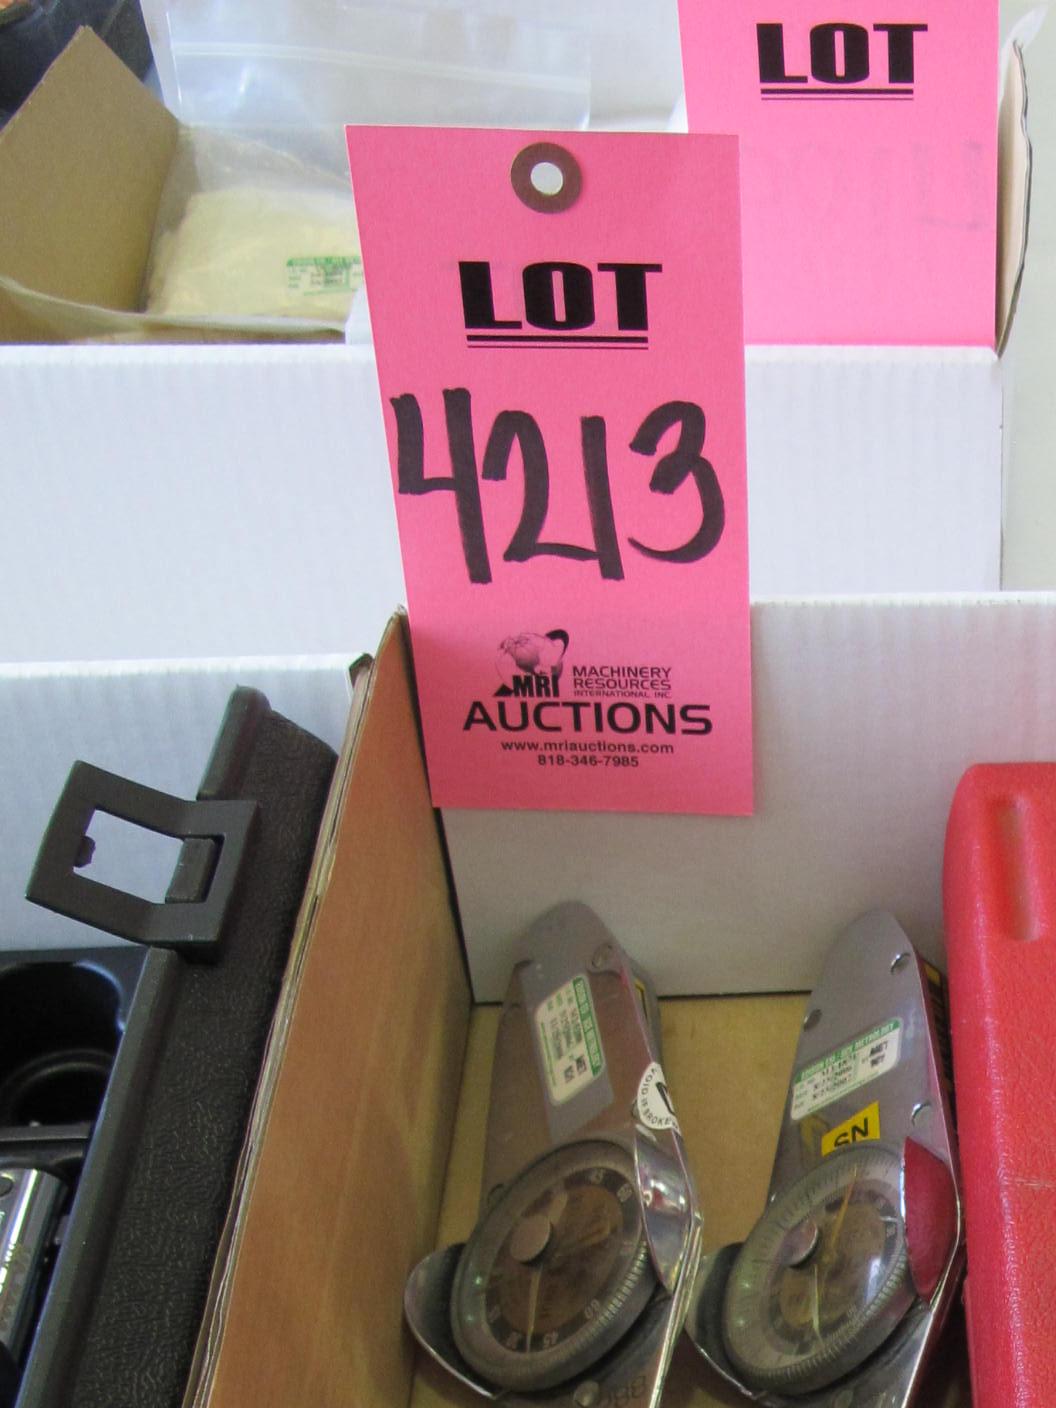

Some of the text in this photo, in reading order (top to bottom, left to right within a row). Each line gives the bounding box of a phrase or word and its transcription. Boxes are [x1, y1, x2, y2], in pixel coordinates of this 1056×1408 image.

[756, 22, 928, 84] LOT
[458, 261, 663, 331] LOT
[389, 386, 726, 584] 4213
[572, 665, 673, 680] MACHINERY
[512, 671, 560, 698] MRI
[573, 679, 672, 691] RESOURCES
[573, 690, 650, 698] INTERNATIONAL
[462, 700, 713, 735] AUCTIONS
[500, 740, 675, 754] www.mriauctions.com
[537, 754, 639, 767] 818-346-7985
